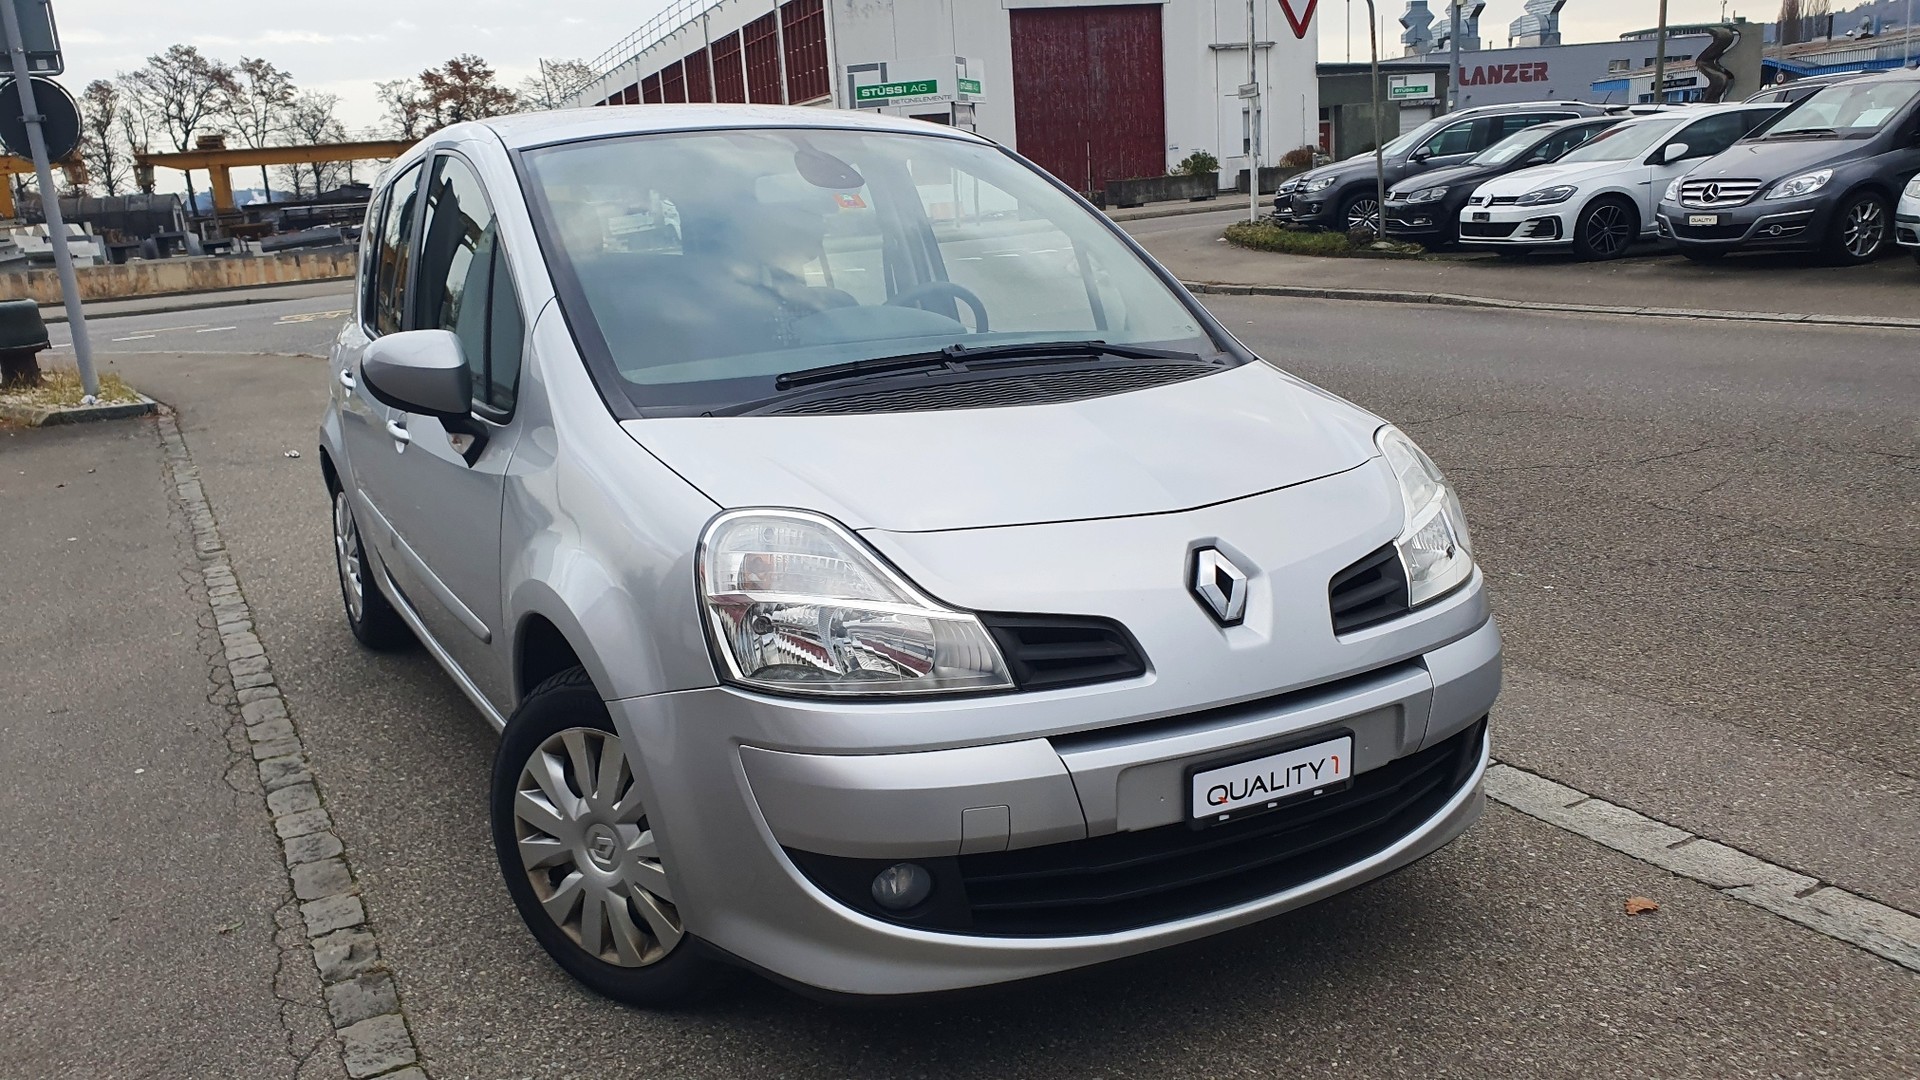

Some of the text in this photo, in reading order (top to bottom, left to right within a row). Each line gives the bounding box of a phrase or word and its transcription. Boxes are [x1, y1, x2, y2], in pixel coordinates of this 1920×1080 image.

[1459, 62, 1549, 86] LANZER
[861, 83, 928, 97] STÜSSI AG
[891, 94, 952, 105] BETONELEMENTE
[1207, 755, 1340, 806] QUALITY 1
